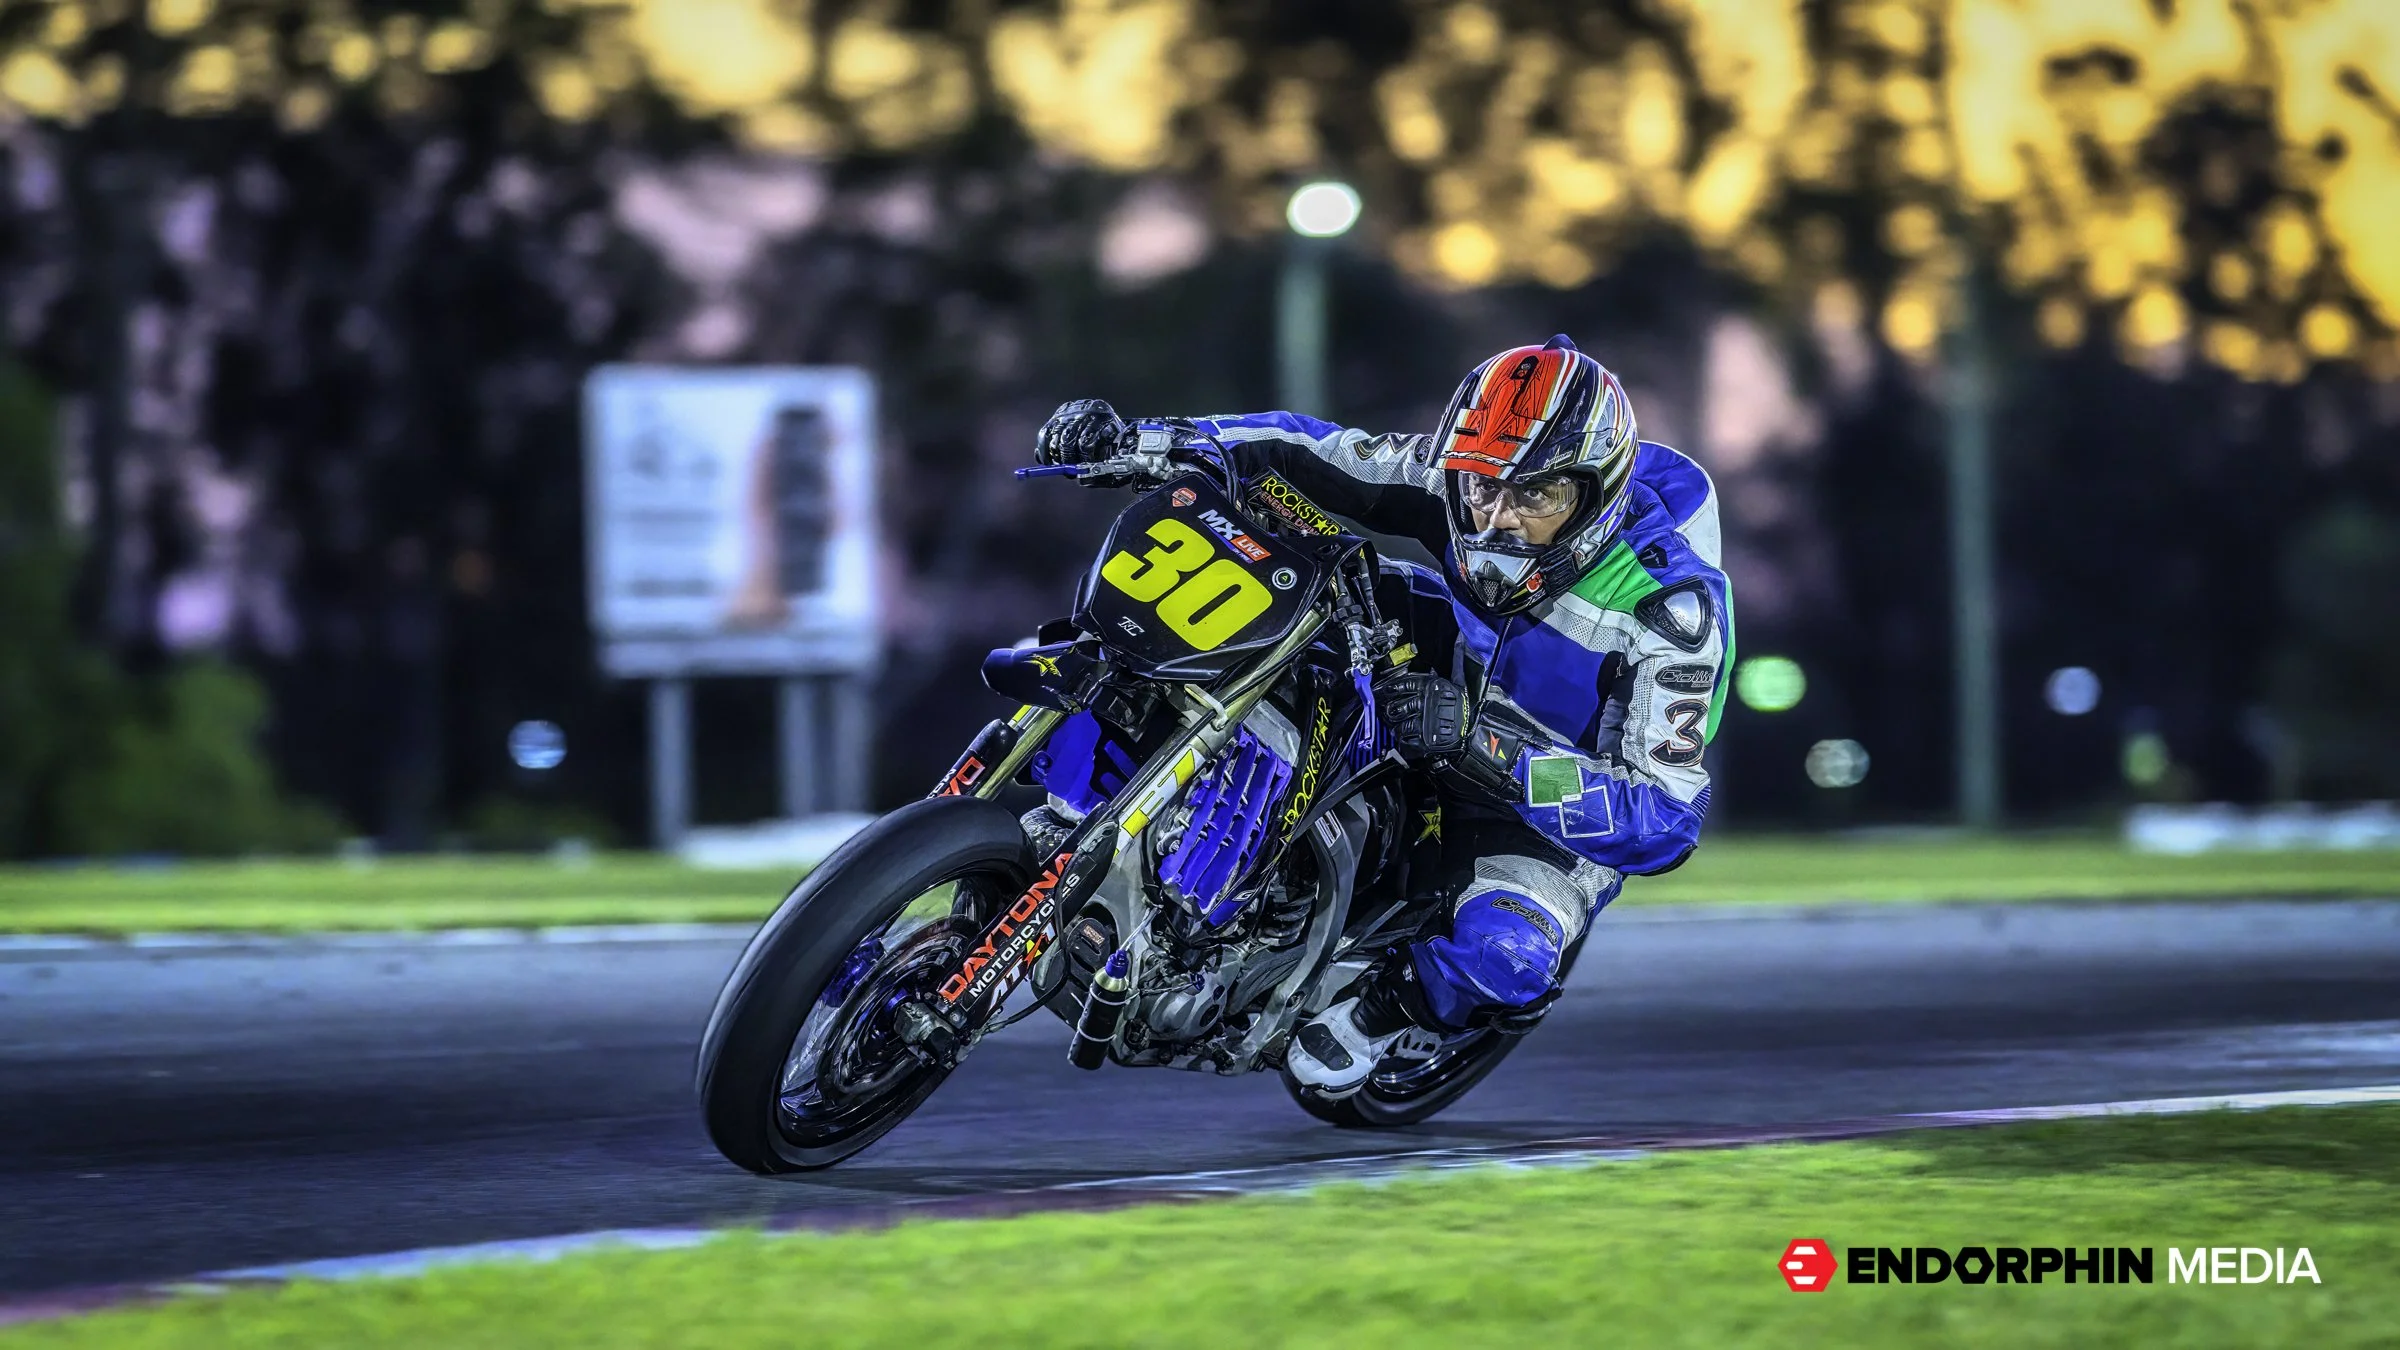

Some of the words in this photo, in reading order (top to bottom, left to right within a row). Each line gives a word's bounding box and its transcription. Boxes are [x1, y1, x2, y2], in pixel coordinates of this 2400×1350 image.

[1197, 508, 1245, 541] MX
[1236, 538, 1266, 559] LIVE
[1261, 491, 1297, 521] ENERGY
[1101, 518, 1273, 651] 30
[1648, 698, 1709, 767] 3
[938, 852, 1074, 1003] DAYTONA
